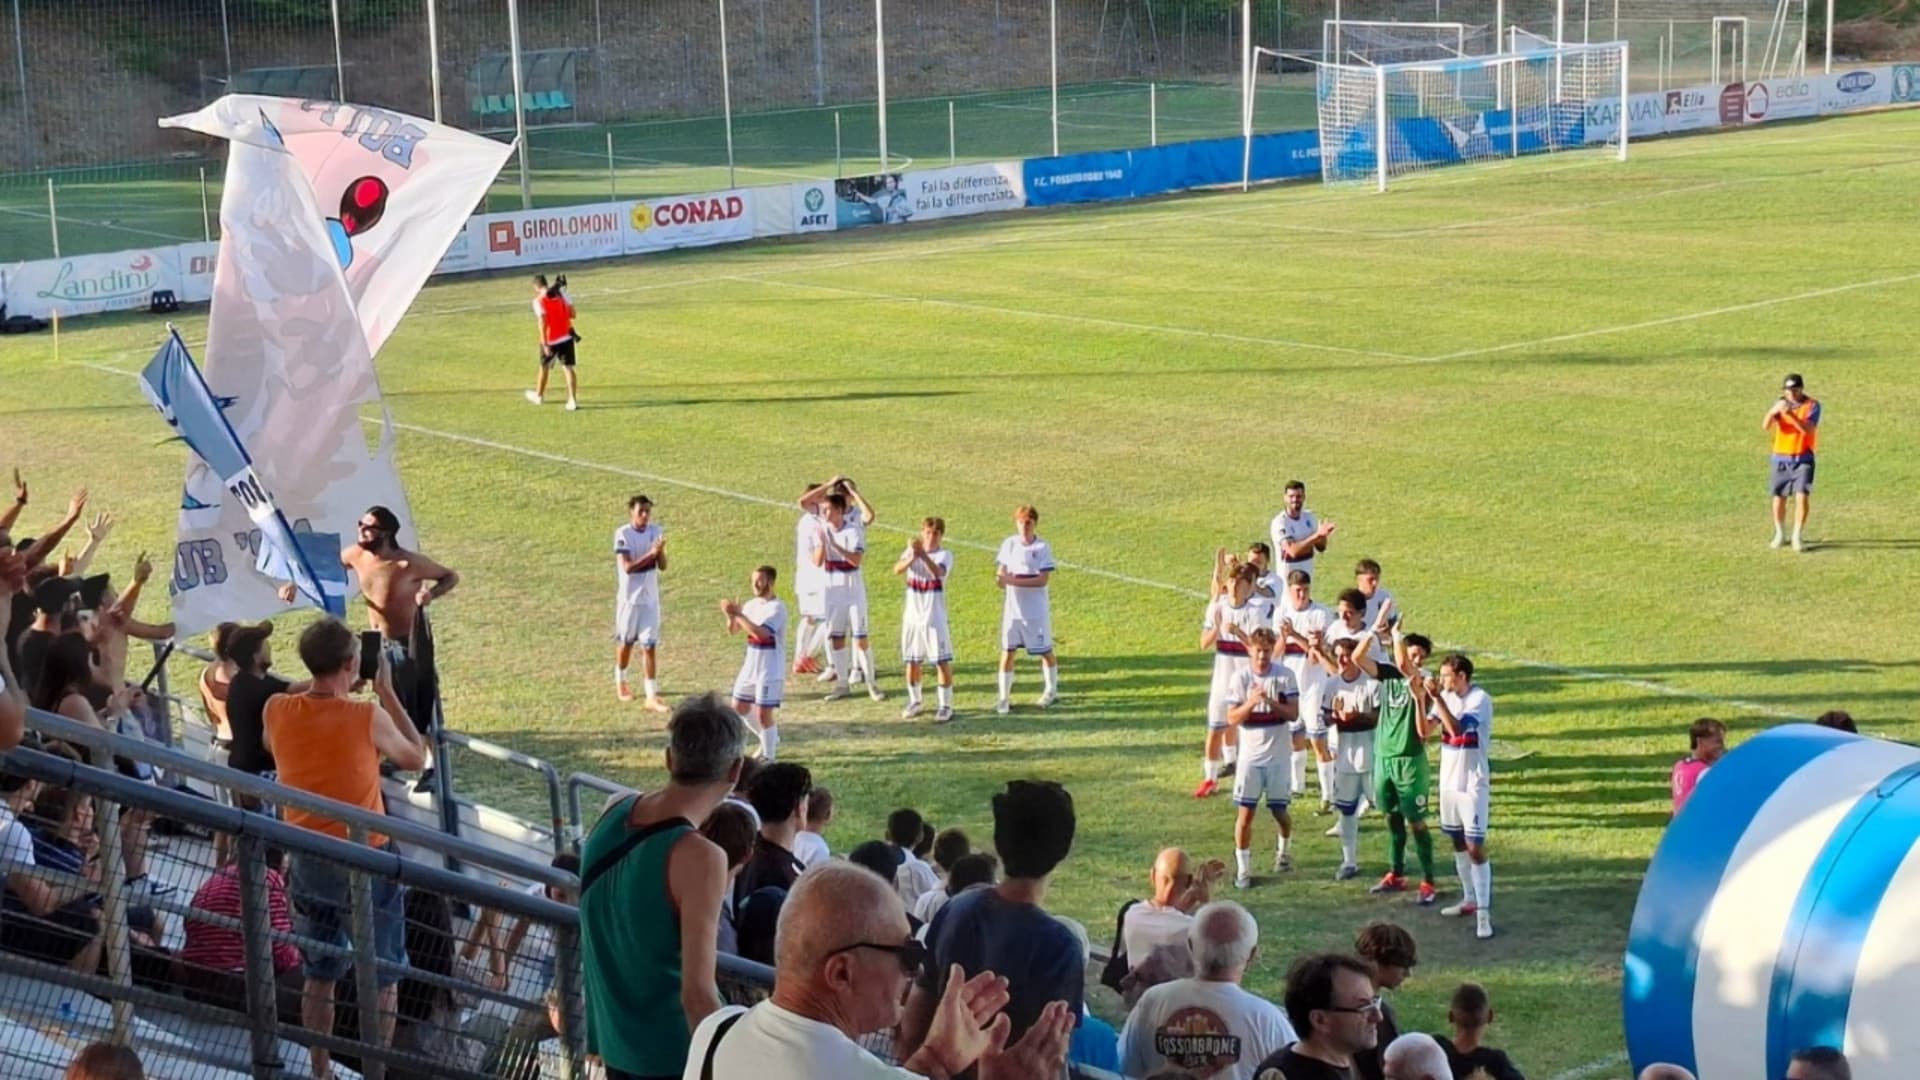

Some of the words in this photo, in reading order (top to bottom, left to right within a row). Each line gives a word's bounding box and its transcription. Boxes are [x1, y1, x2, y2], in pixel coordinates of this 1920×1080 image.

[522, 212, 619, 239] GIROLOMONI
[654, 196, 744, 227] CONAD
[37, 261, 153, 301] Landini
